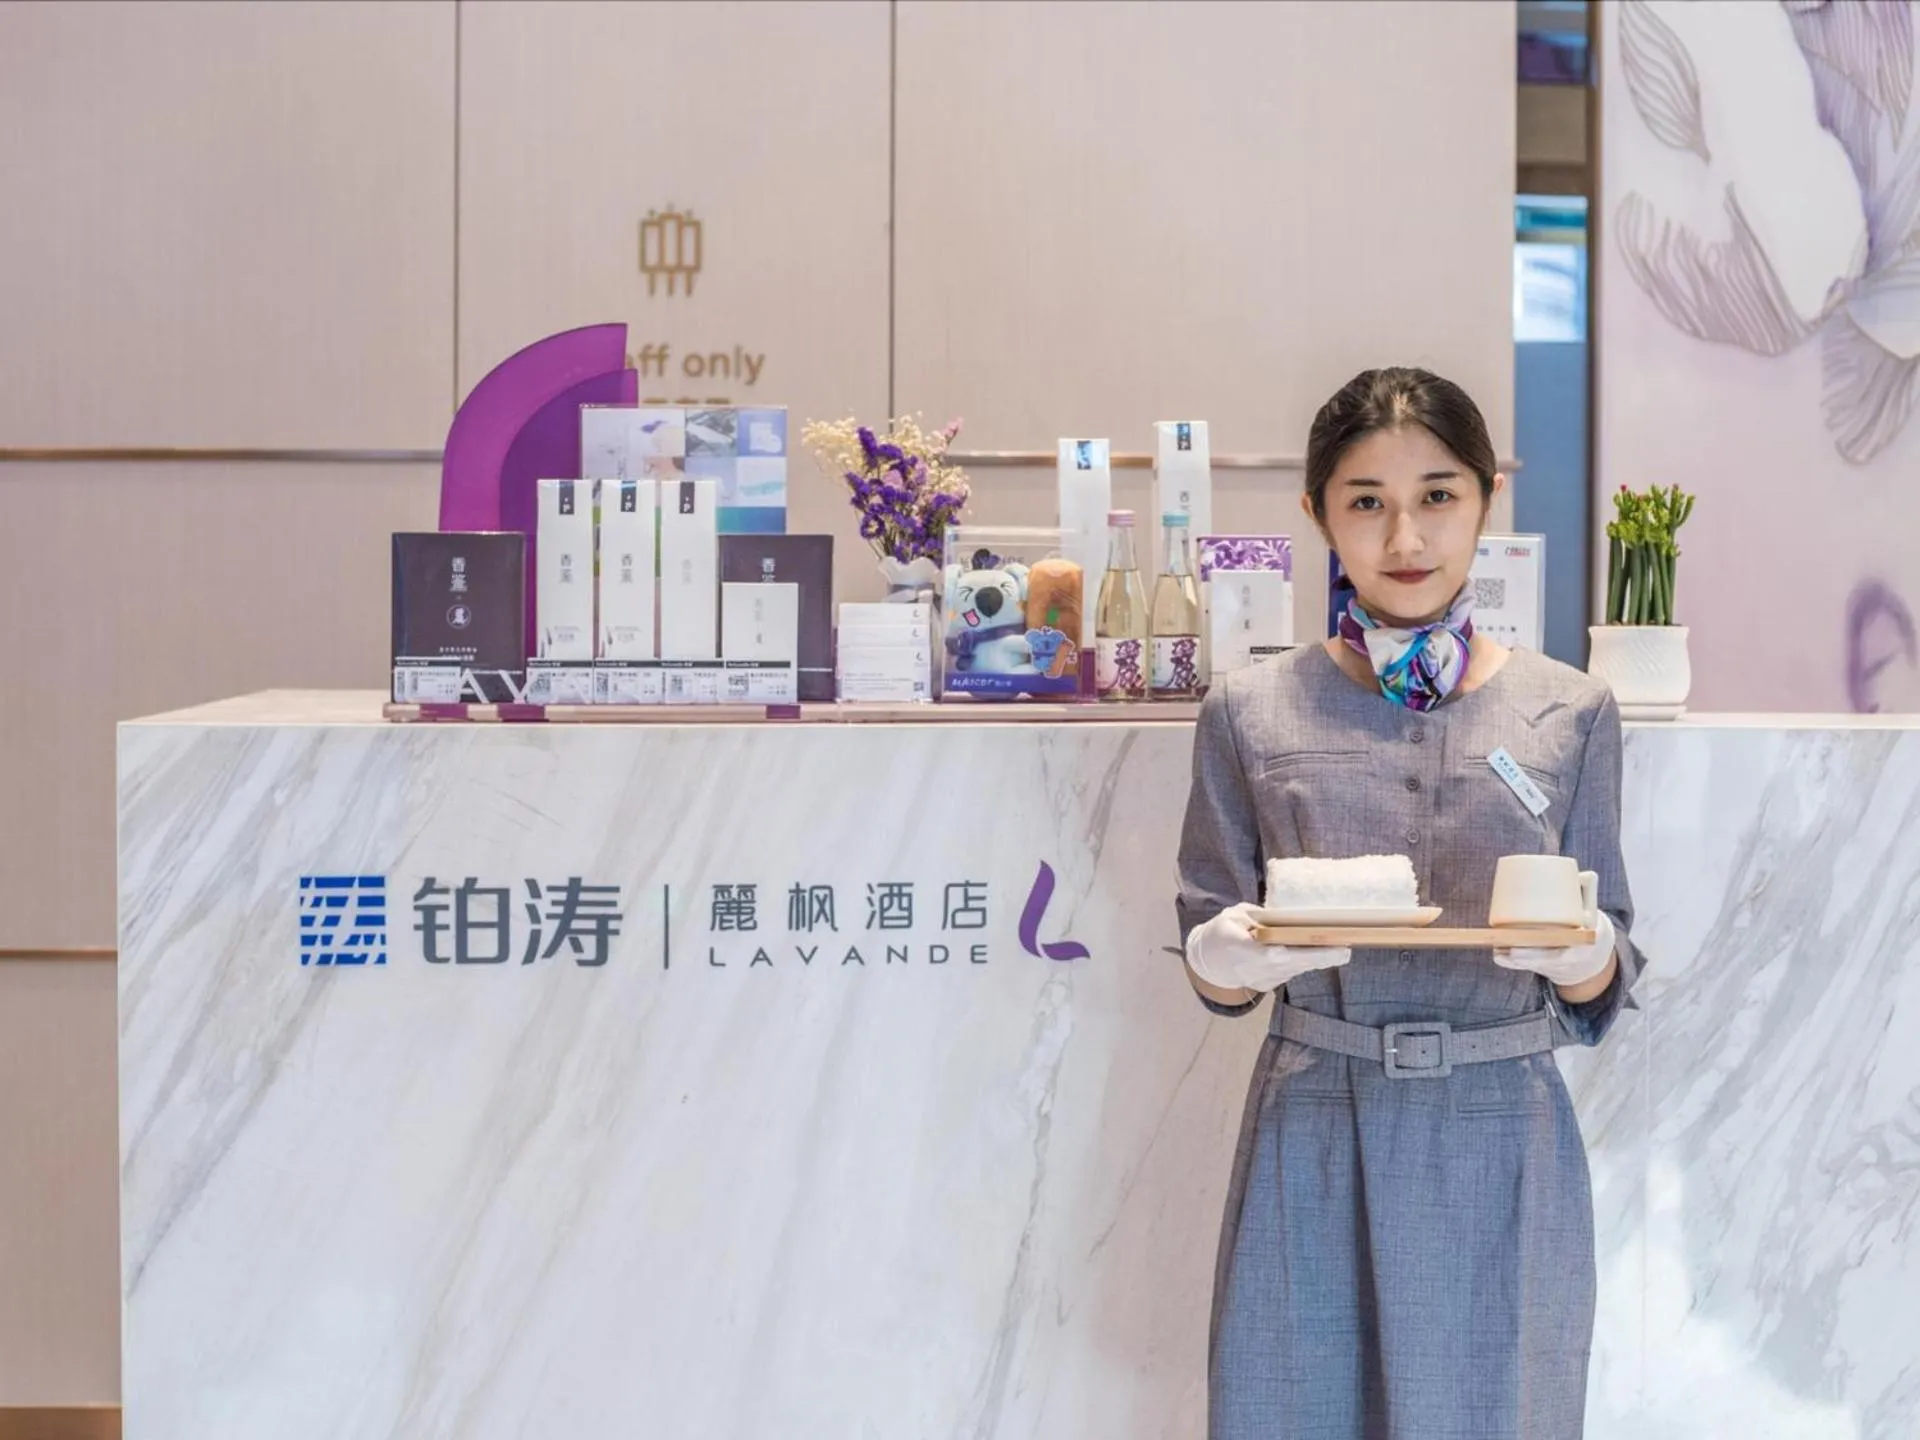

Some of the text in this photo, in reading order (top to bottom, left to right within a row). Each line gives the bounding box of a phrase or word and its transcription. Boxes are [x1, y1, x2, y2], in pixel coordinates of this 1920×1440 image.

[682, 343, 766, 386] only
[413, 876, 623, 967] 铂涛
[709, 881, 989, 933] 麗枫酒店
[709, 944, 989, 967] LAVANDE
